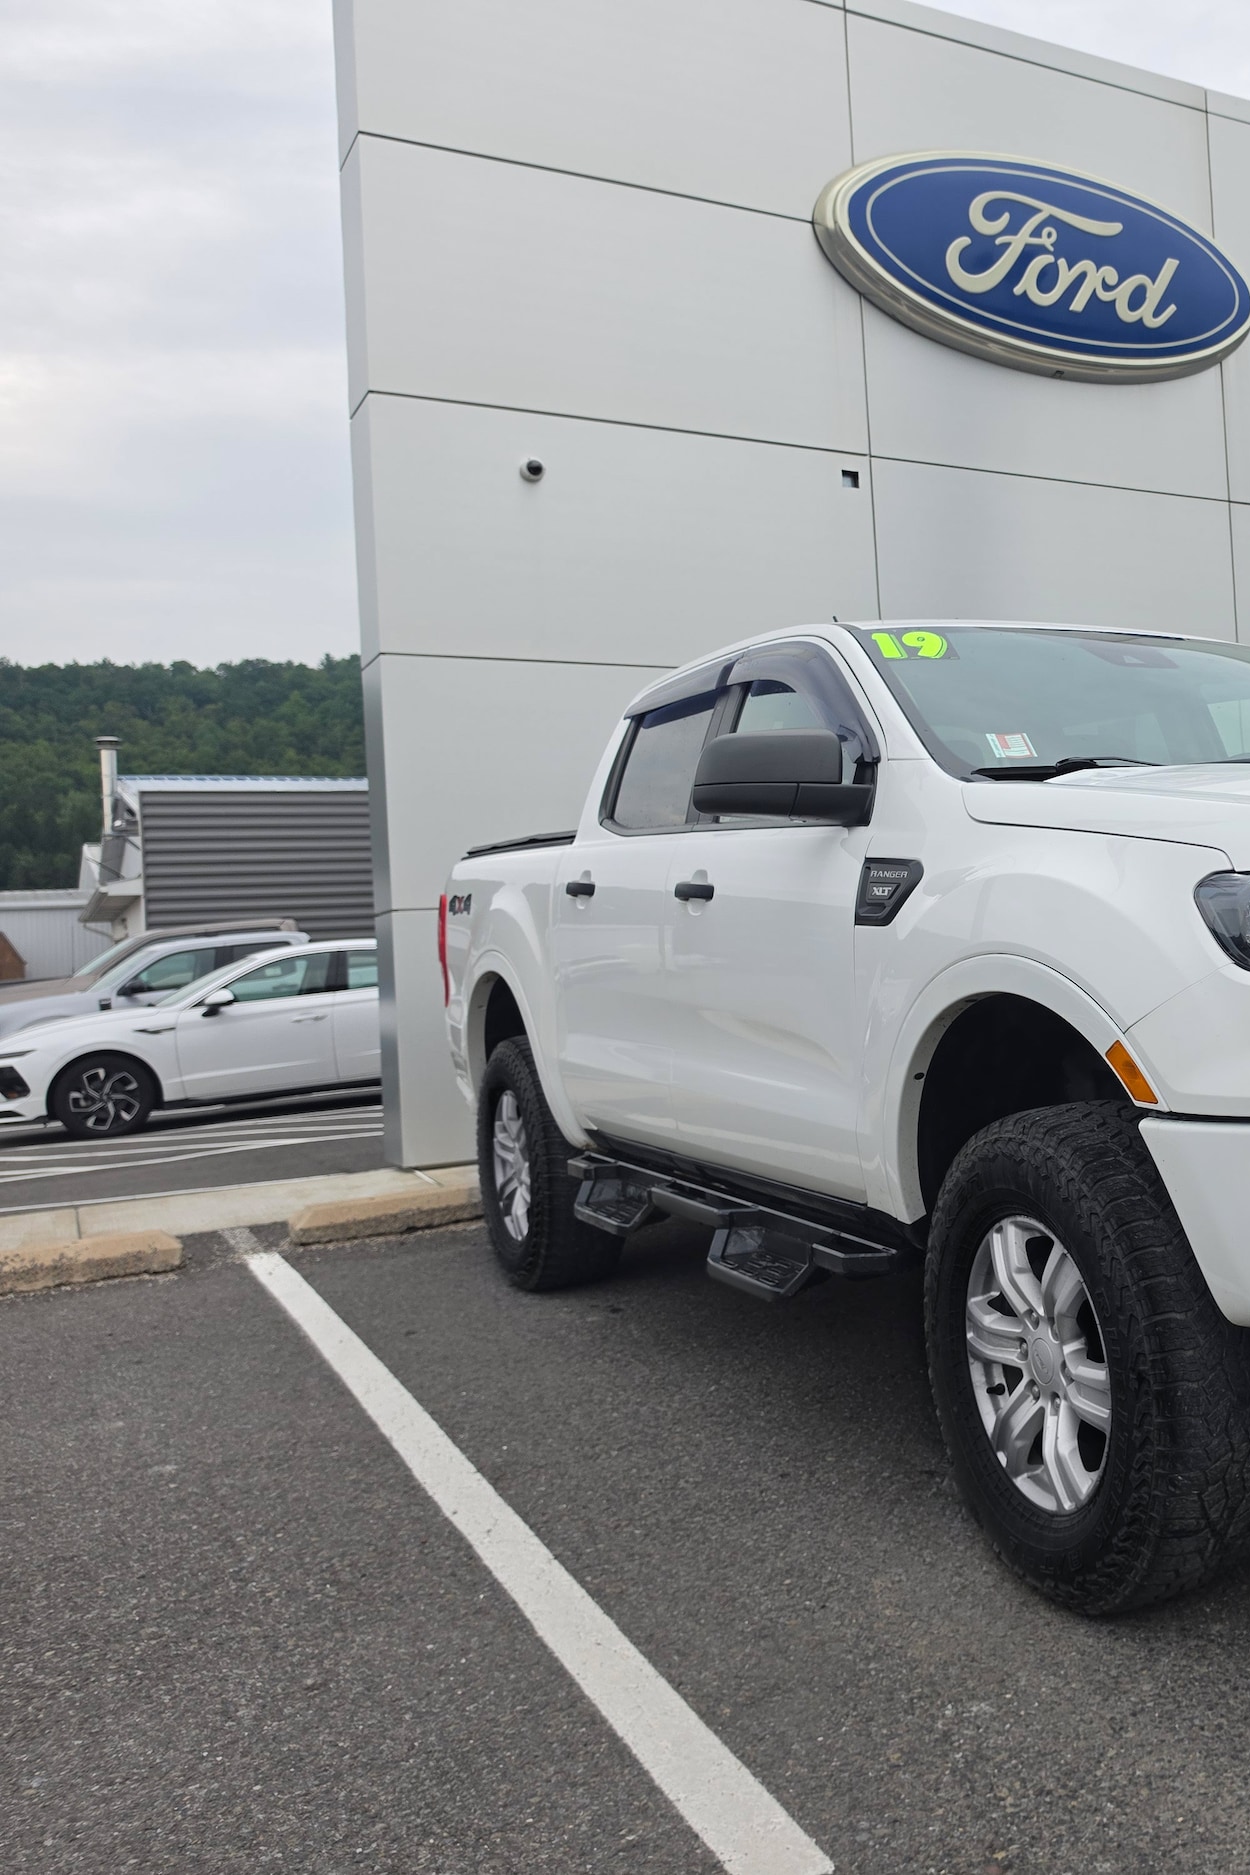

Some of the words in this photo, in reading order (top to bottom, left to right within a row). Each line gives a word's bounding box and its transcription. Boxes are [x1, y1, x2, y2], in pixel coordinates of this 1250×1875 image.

[945, 190, 1180, 329] Ford
[871, 631, 948, 659] 19
[870, 870, 908, 879] RANGER
[871, 886, 892, 896] XLT
